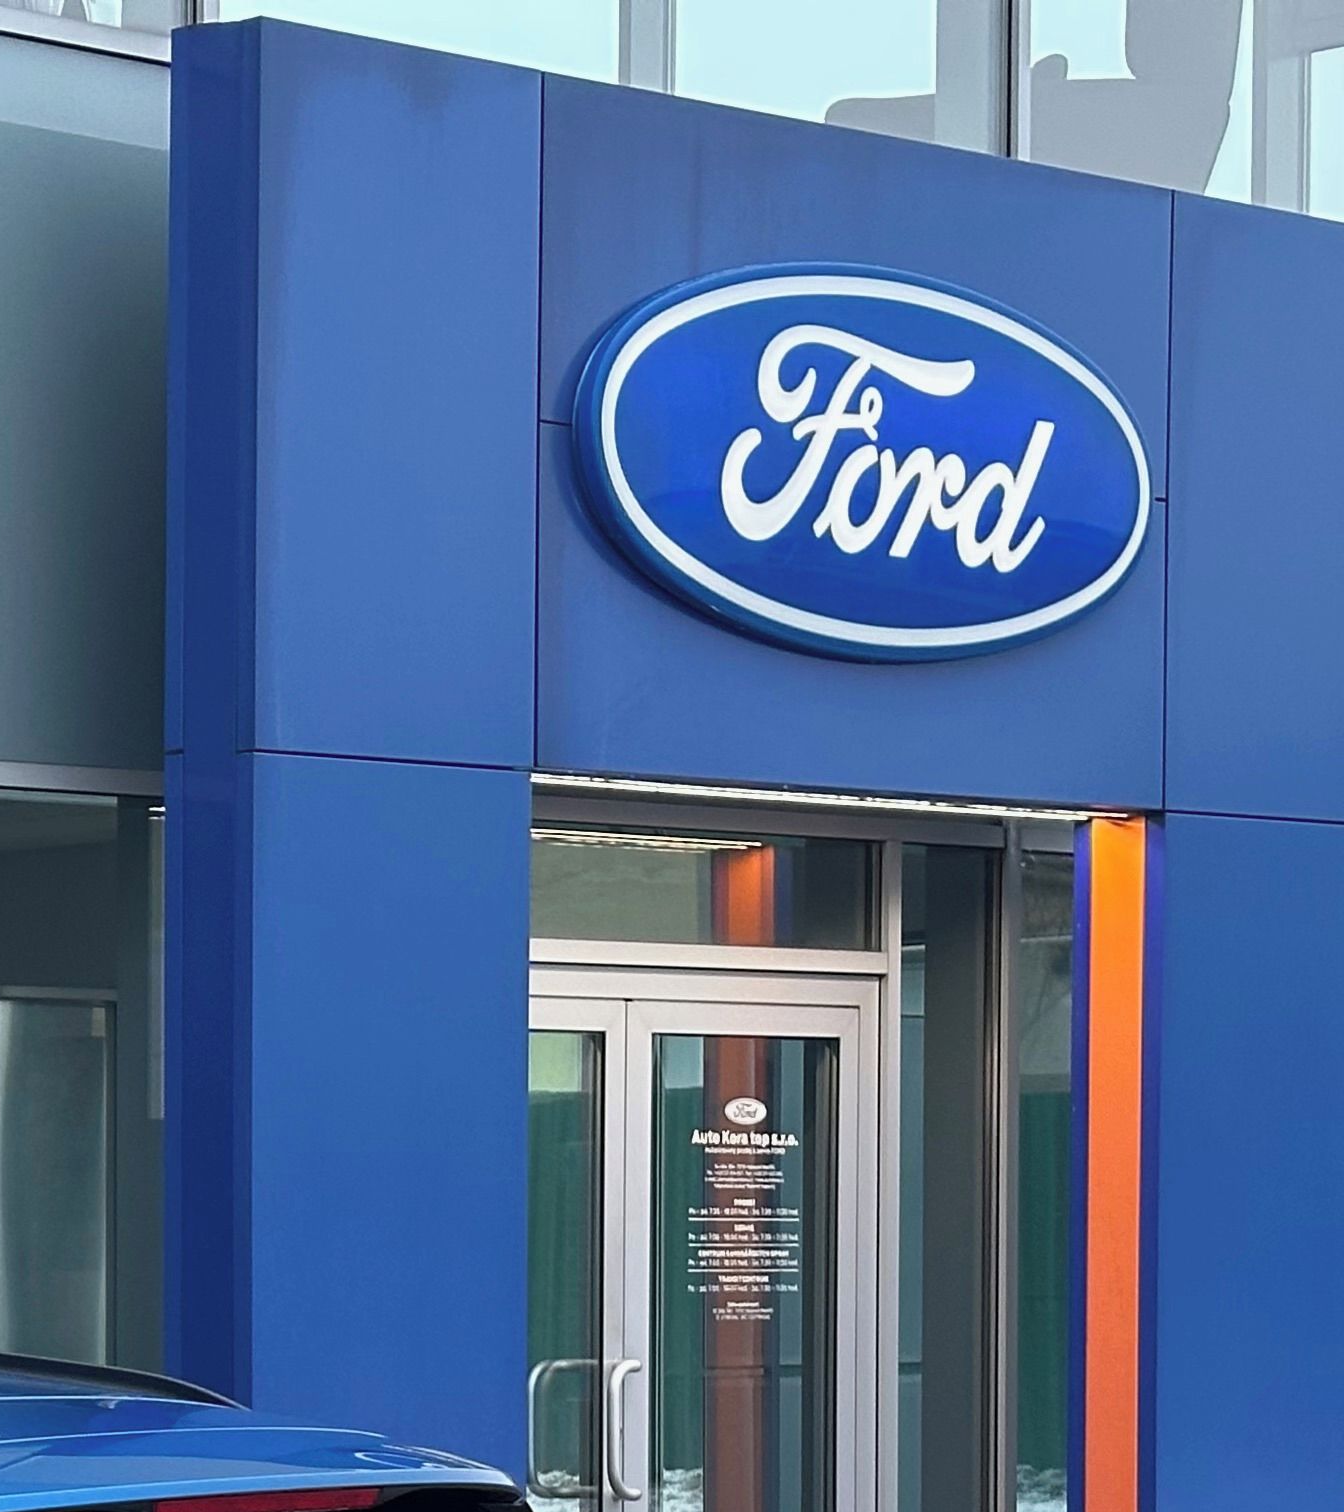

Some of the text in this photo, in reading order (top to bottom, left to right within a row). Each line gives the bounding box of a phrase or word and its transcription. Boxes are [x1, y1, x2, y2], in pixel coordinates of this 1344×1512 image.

[721, 324, 1054, 573] Ford
[691, 1129, 720, 1144] Auto
[721, 1130, 748, 1145] Kora
[750, 1131, 770, 1147] top
